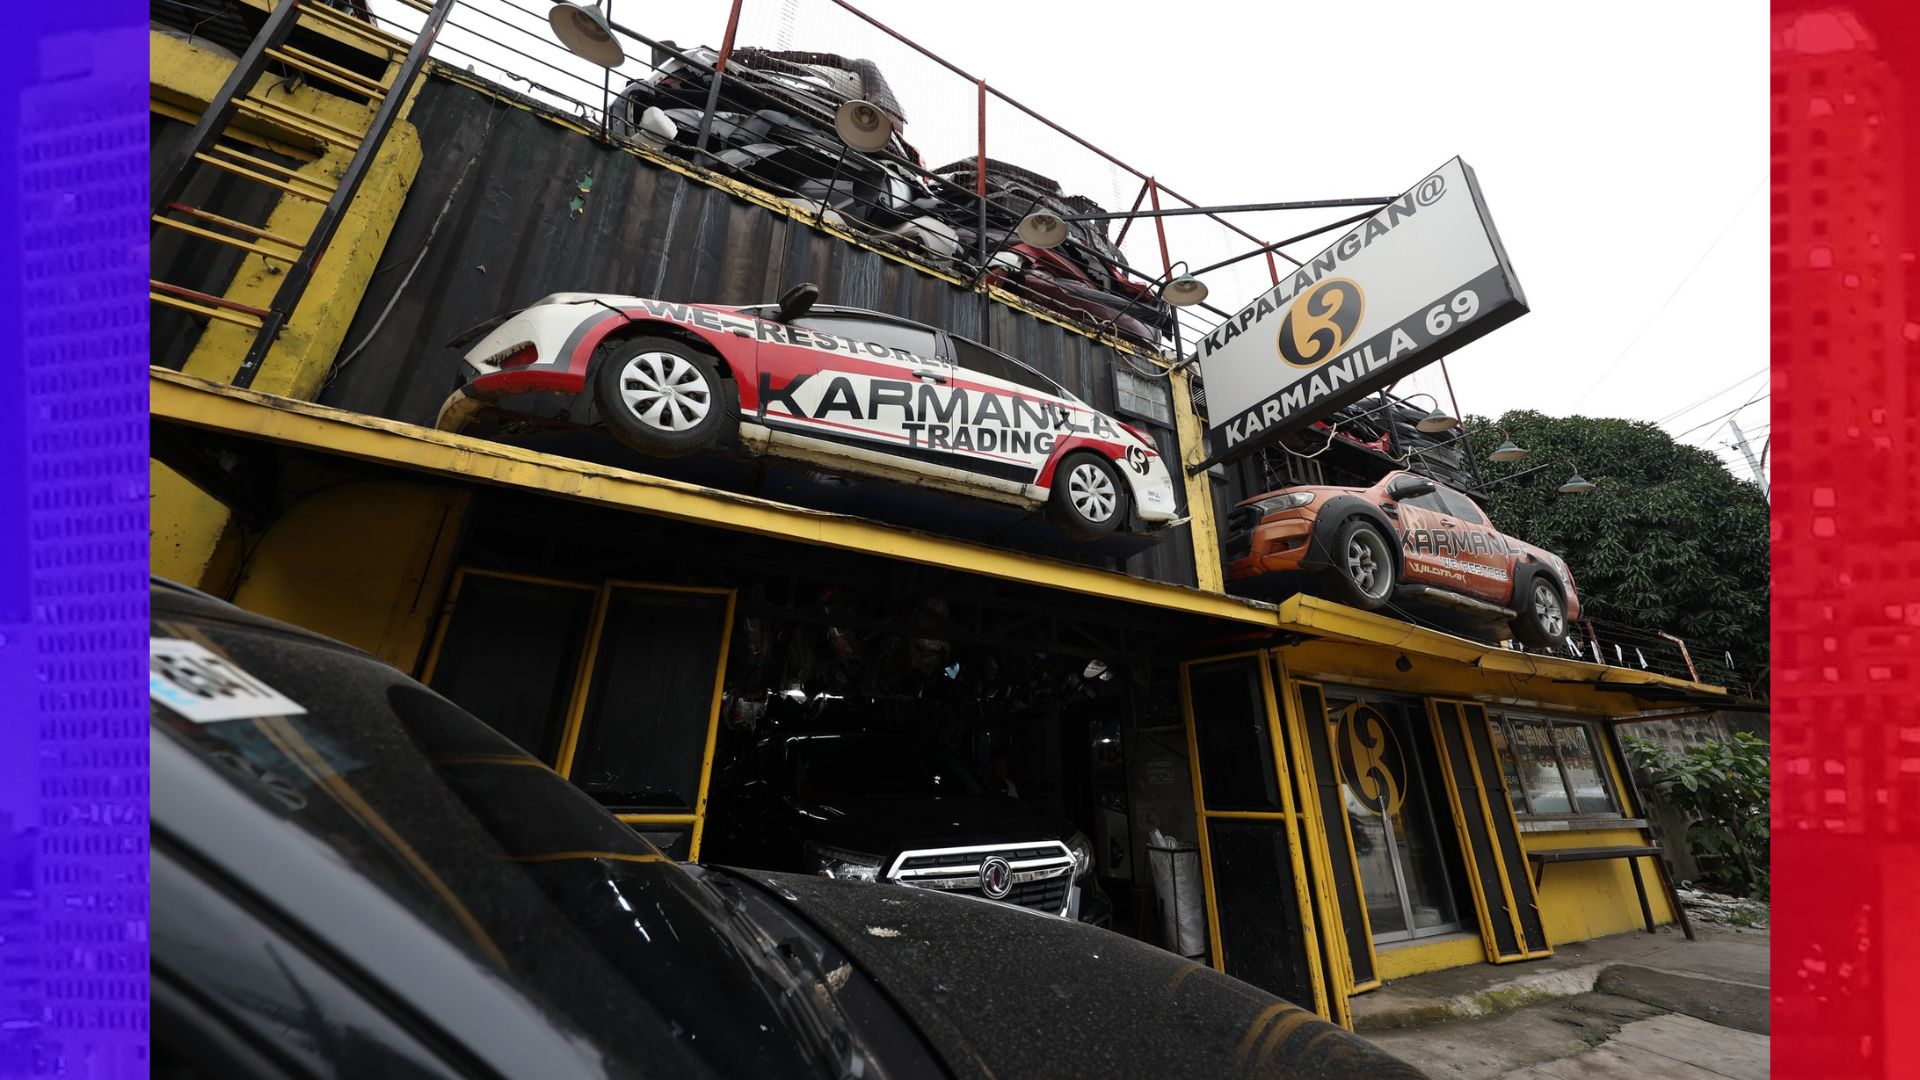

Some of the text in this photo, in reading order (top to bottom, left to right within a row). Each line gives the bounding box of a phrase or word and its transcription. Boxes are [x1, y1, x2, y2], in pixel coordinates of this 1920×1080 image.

[755, 318, 943, 368] RESTOR
[1225, 289, 1480, 448] KARMANILA 69
[901, 422, 1056, 455] TRADING
